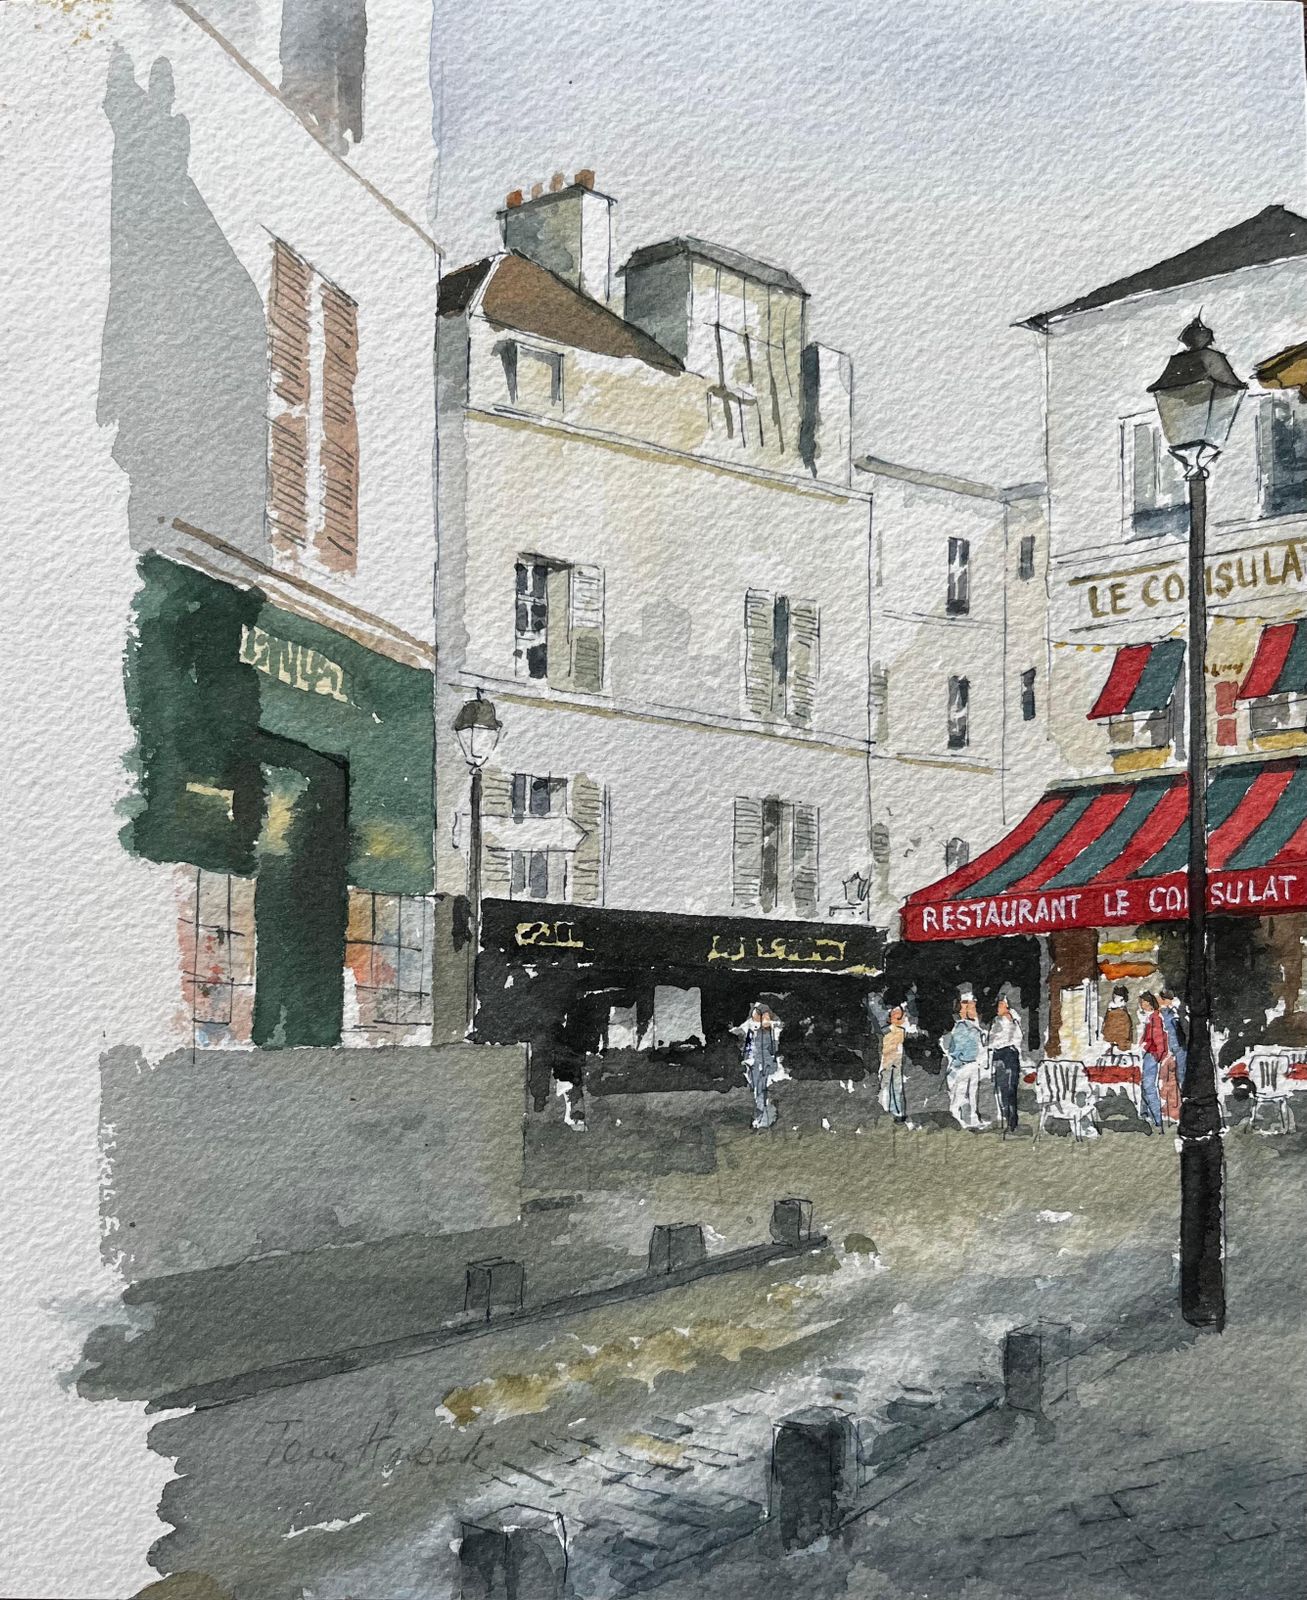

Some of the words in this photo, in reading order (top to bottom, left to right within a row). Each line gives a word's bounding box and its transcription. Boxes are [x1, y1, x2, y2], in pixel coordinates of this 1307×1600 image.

[1087, 582, 1132, 618] LE
[1140, 544, 1307, 608] COSULA
[921, 893, 1082, 932] RESTAURANT
[1103, 888, 1130, 917] LE
[1148, 875, 1298, 913] COSULAT
